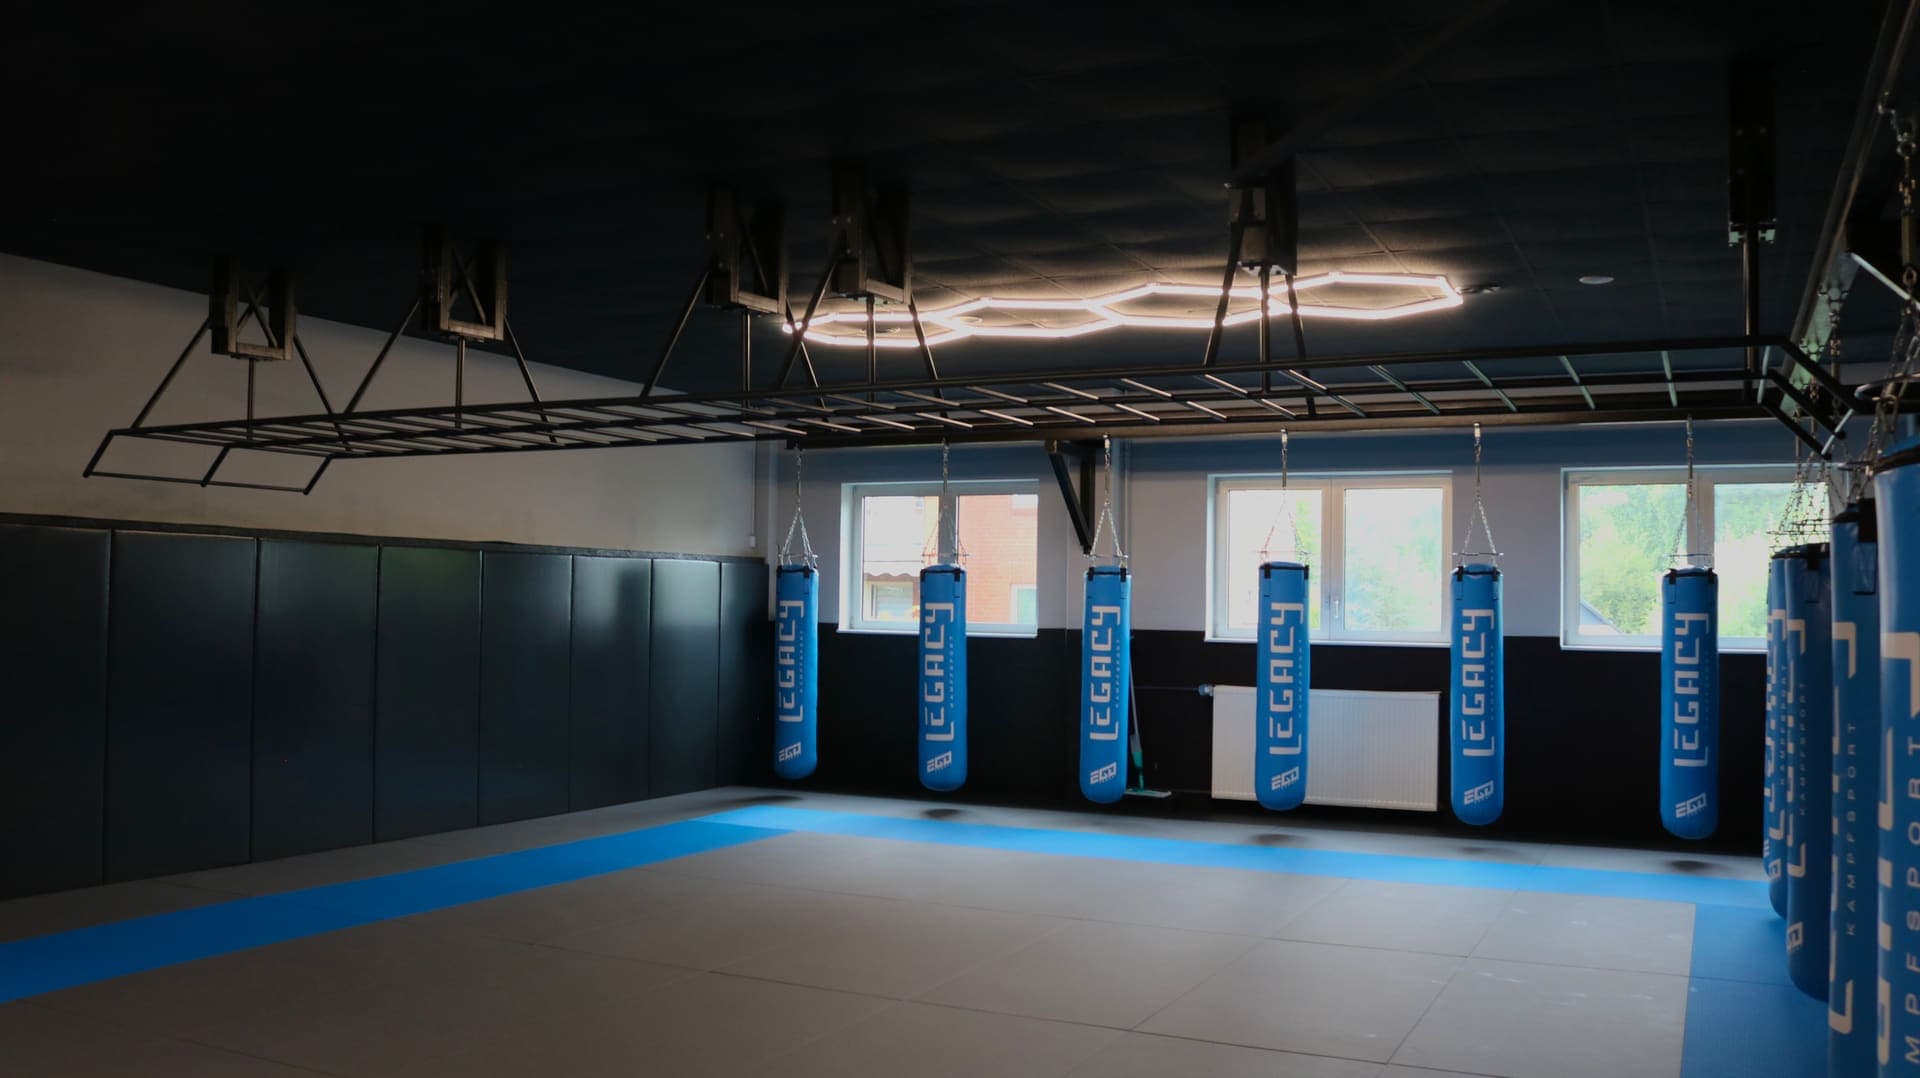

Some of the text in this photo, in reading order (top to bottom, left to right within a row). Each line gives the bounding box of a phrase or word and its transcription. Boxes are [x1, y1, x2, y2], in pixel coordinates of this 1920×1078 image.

[779, 600, 804, 723] LEGACY
[924, 602, 955, 741] LEGACY
[1089, 605, 1121, 741] LEGACY
[1269, 602, 1304, 755] LEGACY
[1462, 609, 1495, 757] LEGACY
[1673, 612, 1709, 767] LEGACY
[1847, 723, 1856, 936] KAMPFSPORT
[1905, 735, 1920, 1065] MPFSPORT
